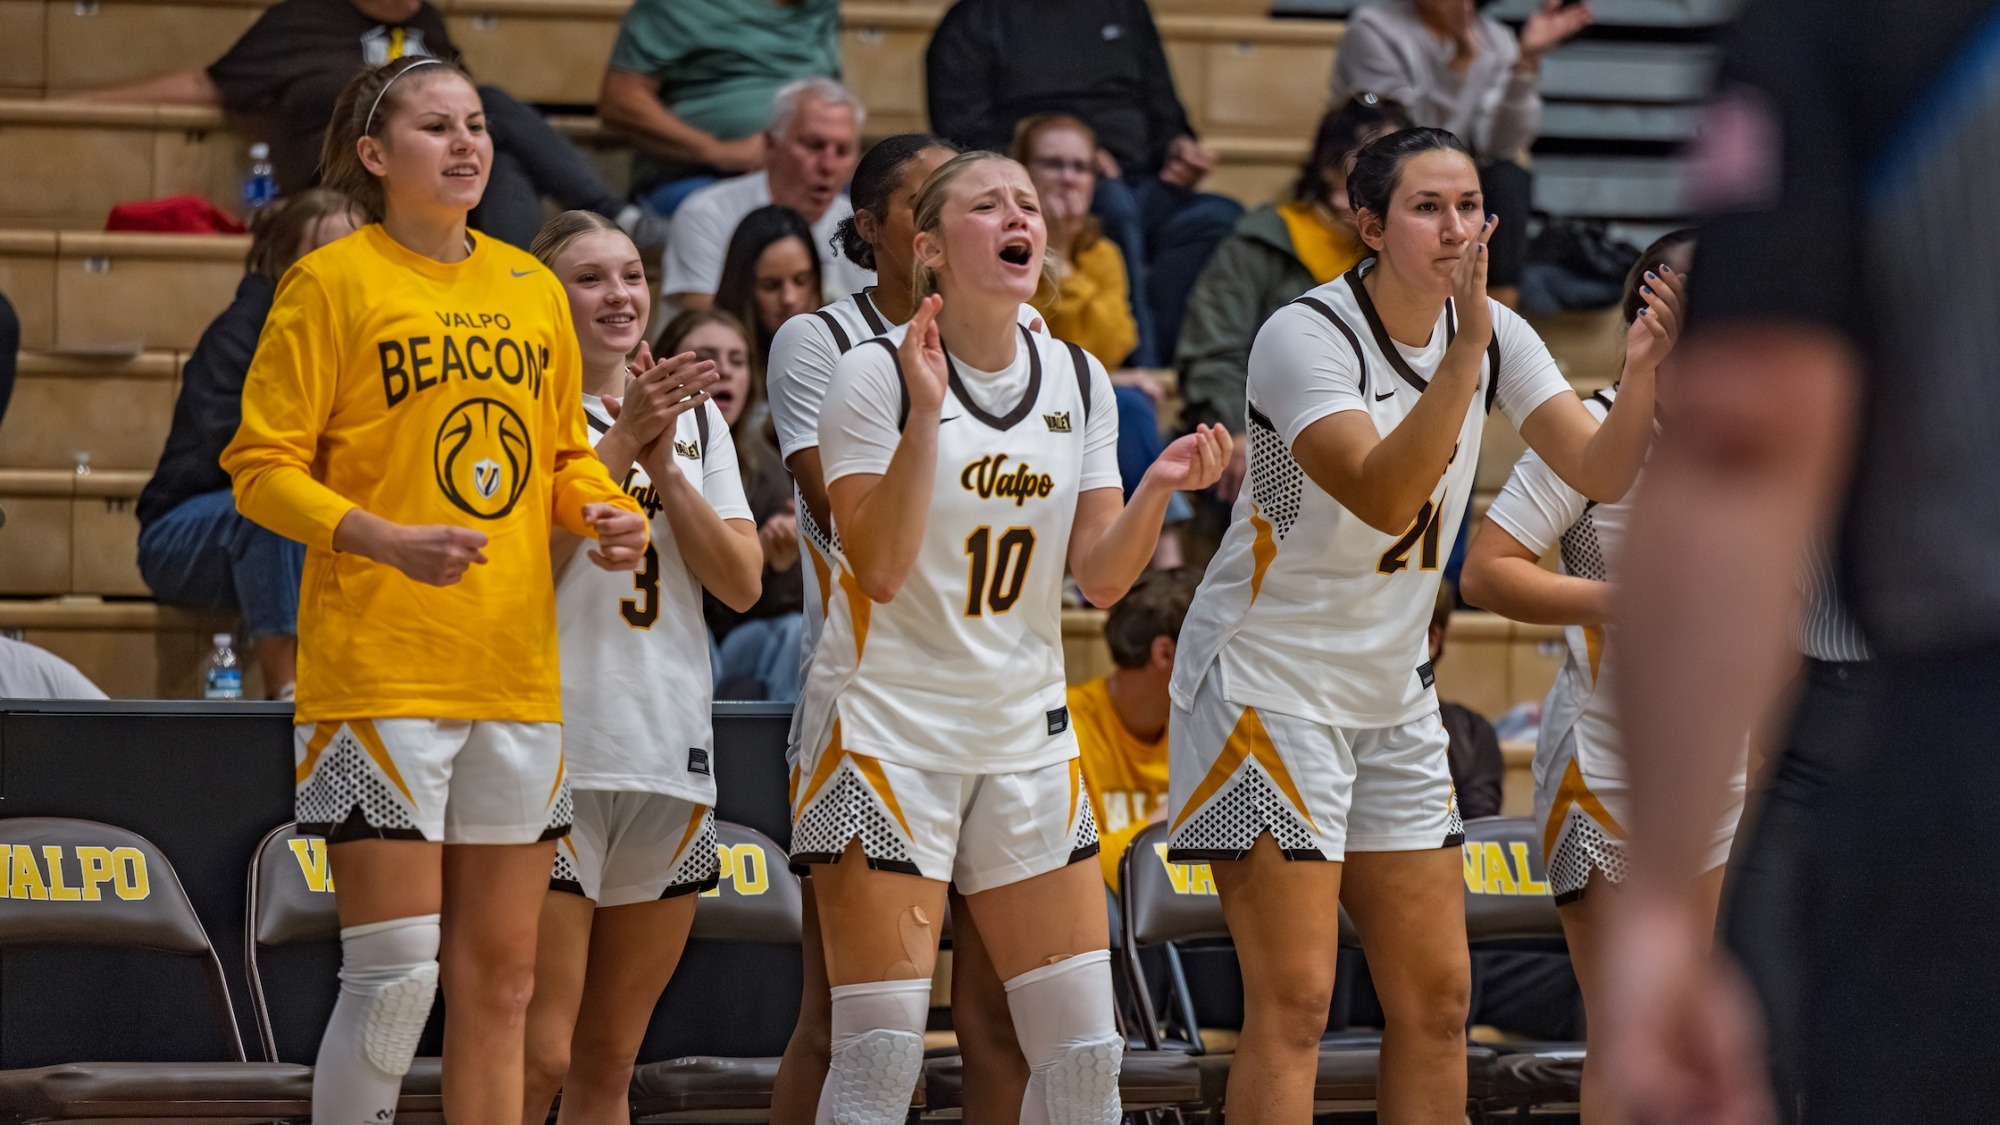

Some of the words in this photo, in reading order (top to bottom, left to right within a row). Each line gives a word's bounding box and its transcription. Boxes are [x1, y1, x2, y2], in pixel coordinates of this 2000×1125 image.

[435, 311, 511, 330] VALPO
[960, 453, 1055, 507] Valpo
[1376, 485, 1449, 576] 21
[619, 540, 660, 630] 3
[964, 525, 1037, 618] 10
[0, 844, 151, 901] ALPO
[1462, 842, 1553, 896] VAL
